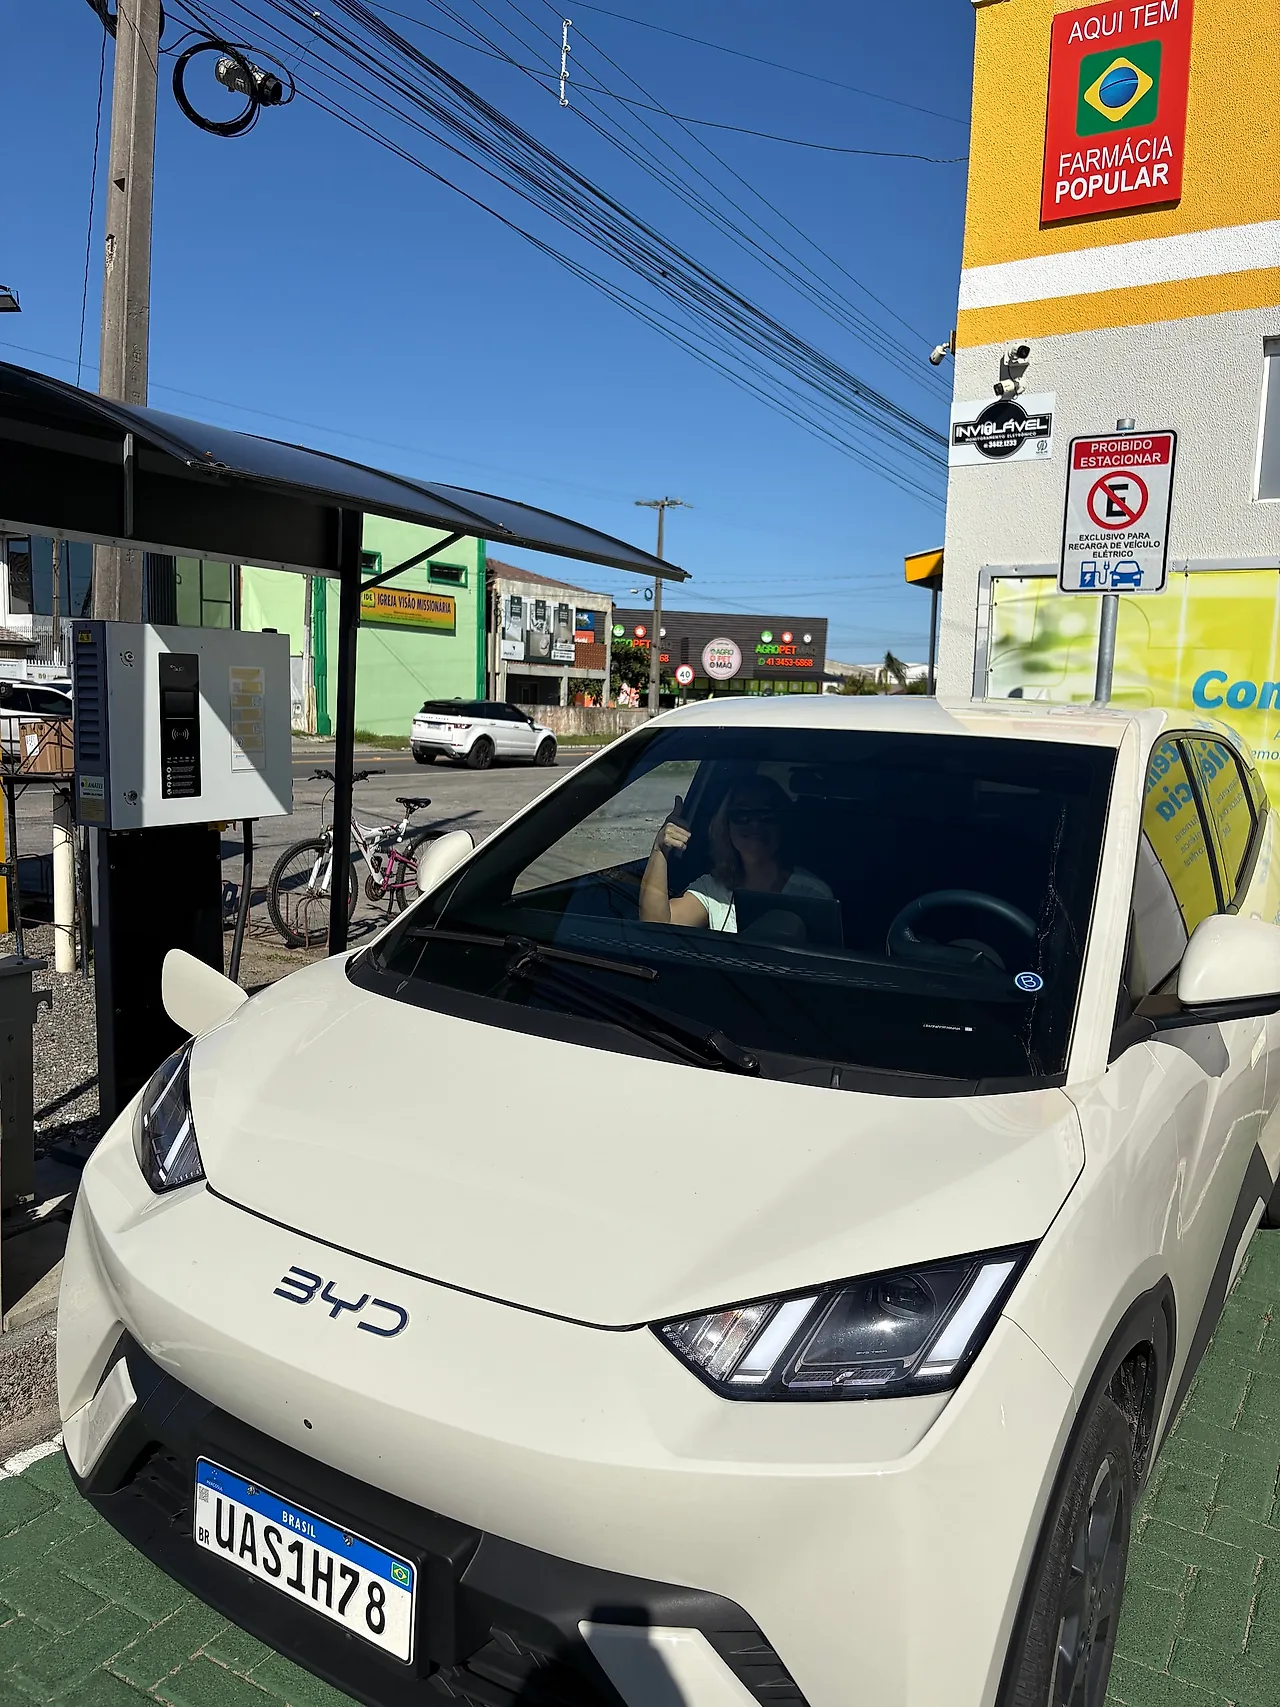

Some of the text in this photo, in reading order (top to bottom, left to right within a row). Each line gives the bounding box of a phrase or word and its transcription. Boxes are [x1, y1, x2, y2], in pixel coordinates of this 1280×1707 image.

[1067, 0, 1178, 44] AQUI TEM
[1059, 136, 1173, 177] FARMÁCIA
[1055, 163, 1169, 203] POPULAR
[1091, 439, 1152, 453] PROIBIDO
[1080, 452, 1161, 467] ESTACIONAR
[1106, 484, 1129, 517] E
[1079, 532, 1150, 542] EXCLUSIVO PARA
[1110, 541, 1121, 549] DE
[1124, 540, 1160, 549] VEÍCULO
[1092, 550, 1133, 558] ELÉTRICO
[363, 593, 373, 601] IDE
[377, 593, 451, 614] IGREJA VISÃO MISSIONÁRIA
[766, 658, 775, 666] 41
[273, 1266, 410, 1338] BYD
[282, 1510, 316, 1539] BRASIL
[198, 1526, 210, 1546] BR
[215, 1497, 386, 1635] UAS1H78
